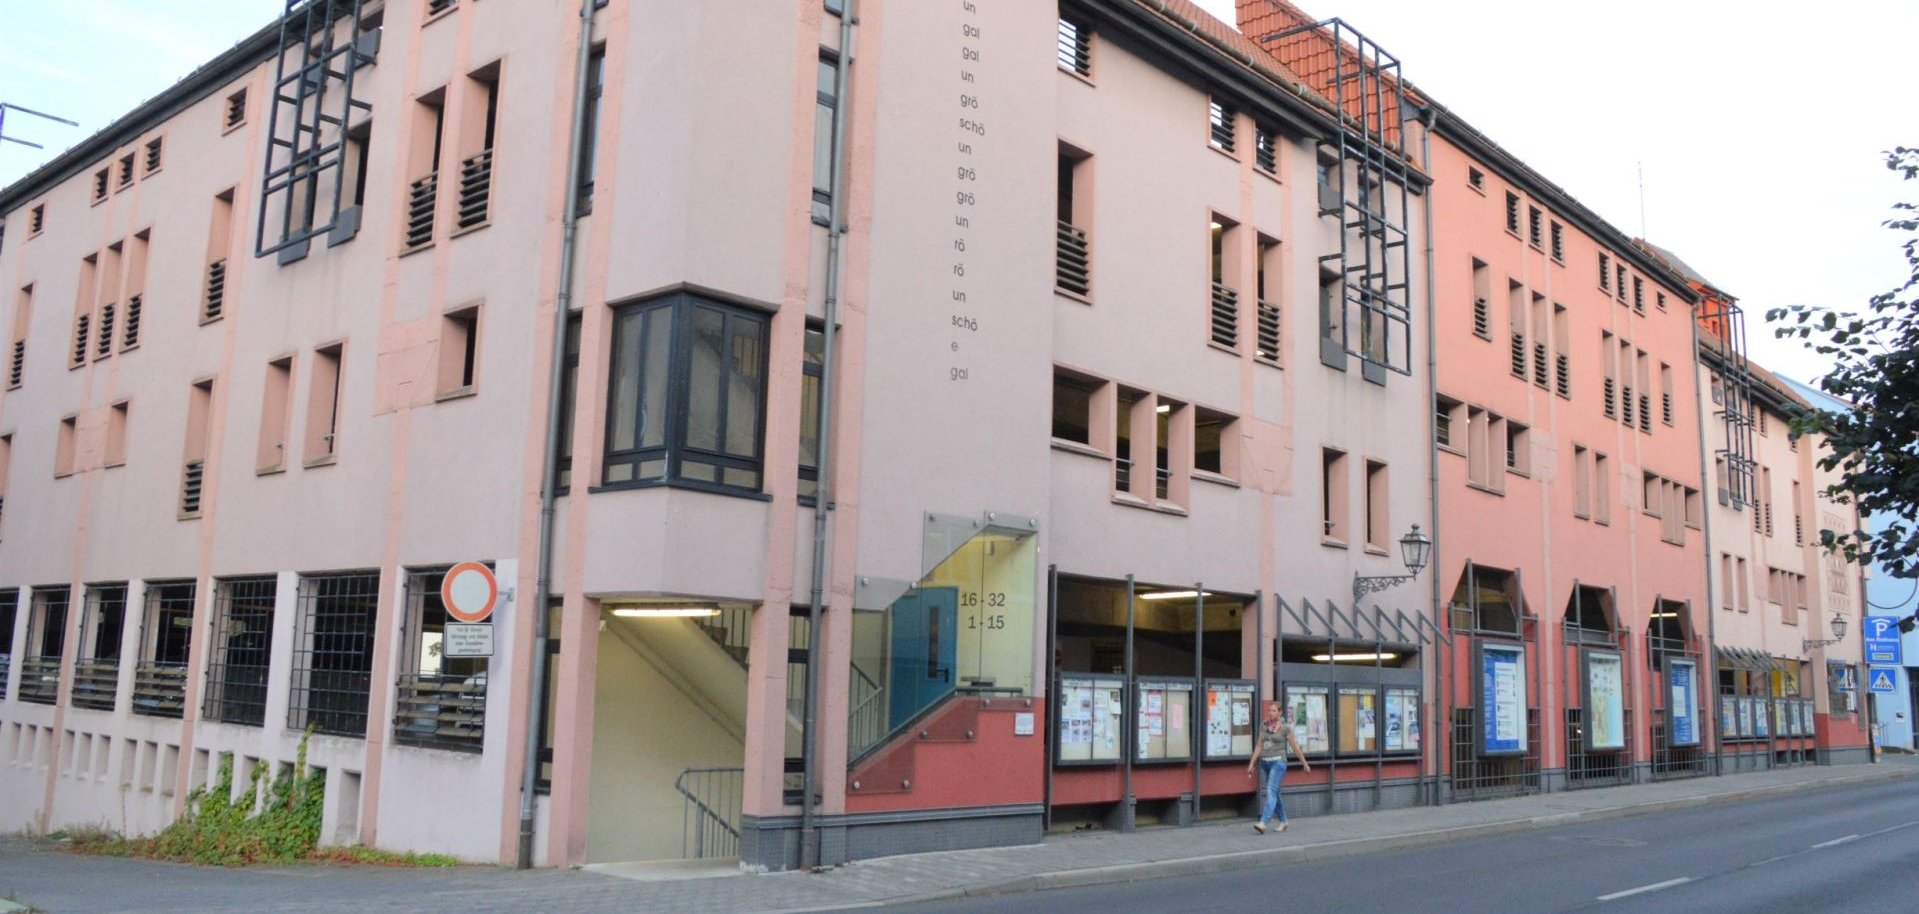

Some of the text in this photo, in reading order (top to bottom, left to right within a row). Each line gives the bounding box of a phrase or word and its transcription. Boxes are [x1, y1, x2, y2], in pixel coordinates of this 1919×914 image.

[963, 0, 976, 13] un
[963, 23, 980, 38] gal
[962, 47, 979, 61] gal
[961, 70, 974, 82] un
[958, 142, 971, 154] un
[955, 216, 968, 228] un
[952, 290, 966, 302] un
[951, 342, 958, 352] e
[950, 367, 968, 381] gal
[1876, 622, 1888, 637] P
